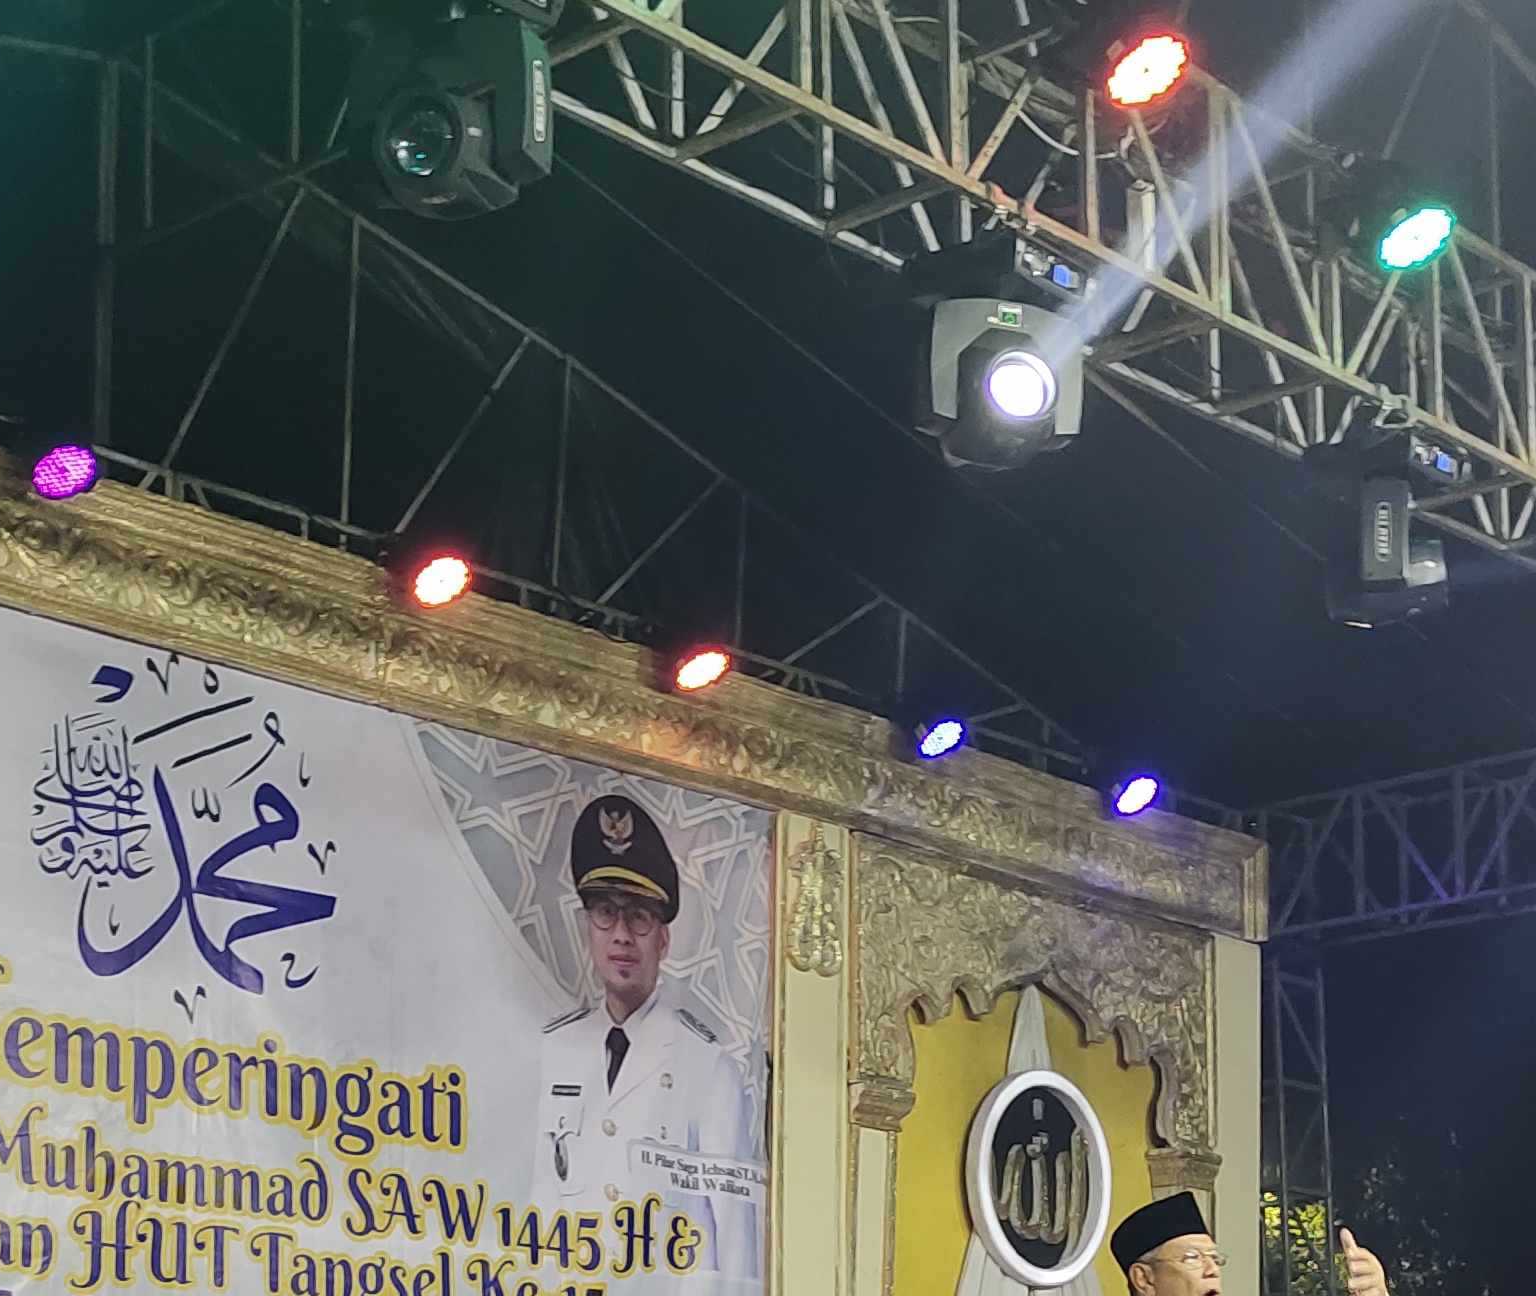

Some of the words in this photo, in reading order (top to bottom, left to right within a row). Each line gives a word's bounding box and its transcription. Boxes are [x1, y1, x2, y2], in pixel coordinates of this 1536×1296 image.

[68, 1199, 240, 1289] HUT
[345, 1168, 486, 1244] SAW
[495, 1206, 602, 1272] 1445
[610, 1197, 662, 1274] H
[666, 1217, 702, 1272] &
